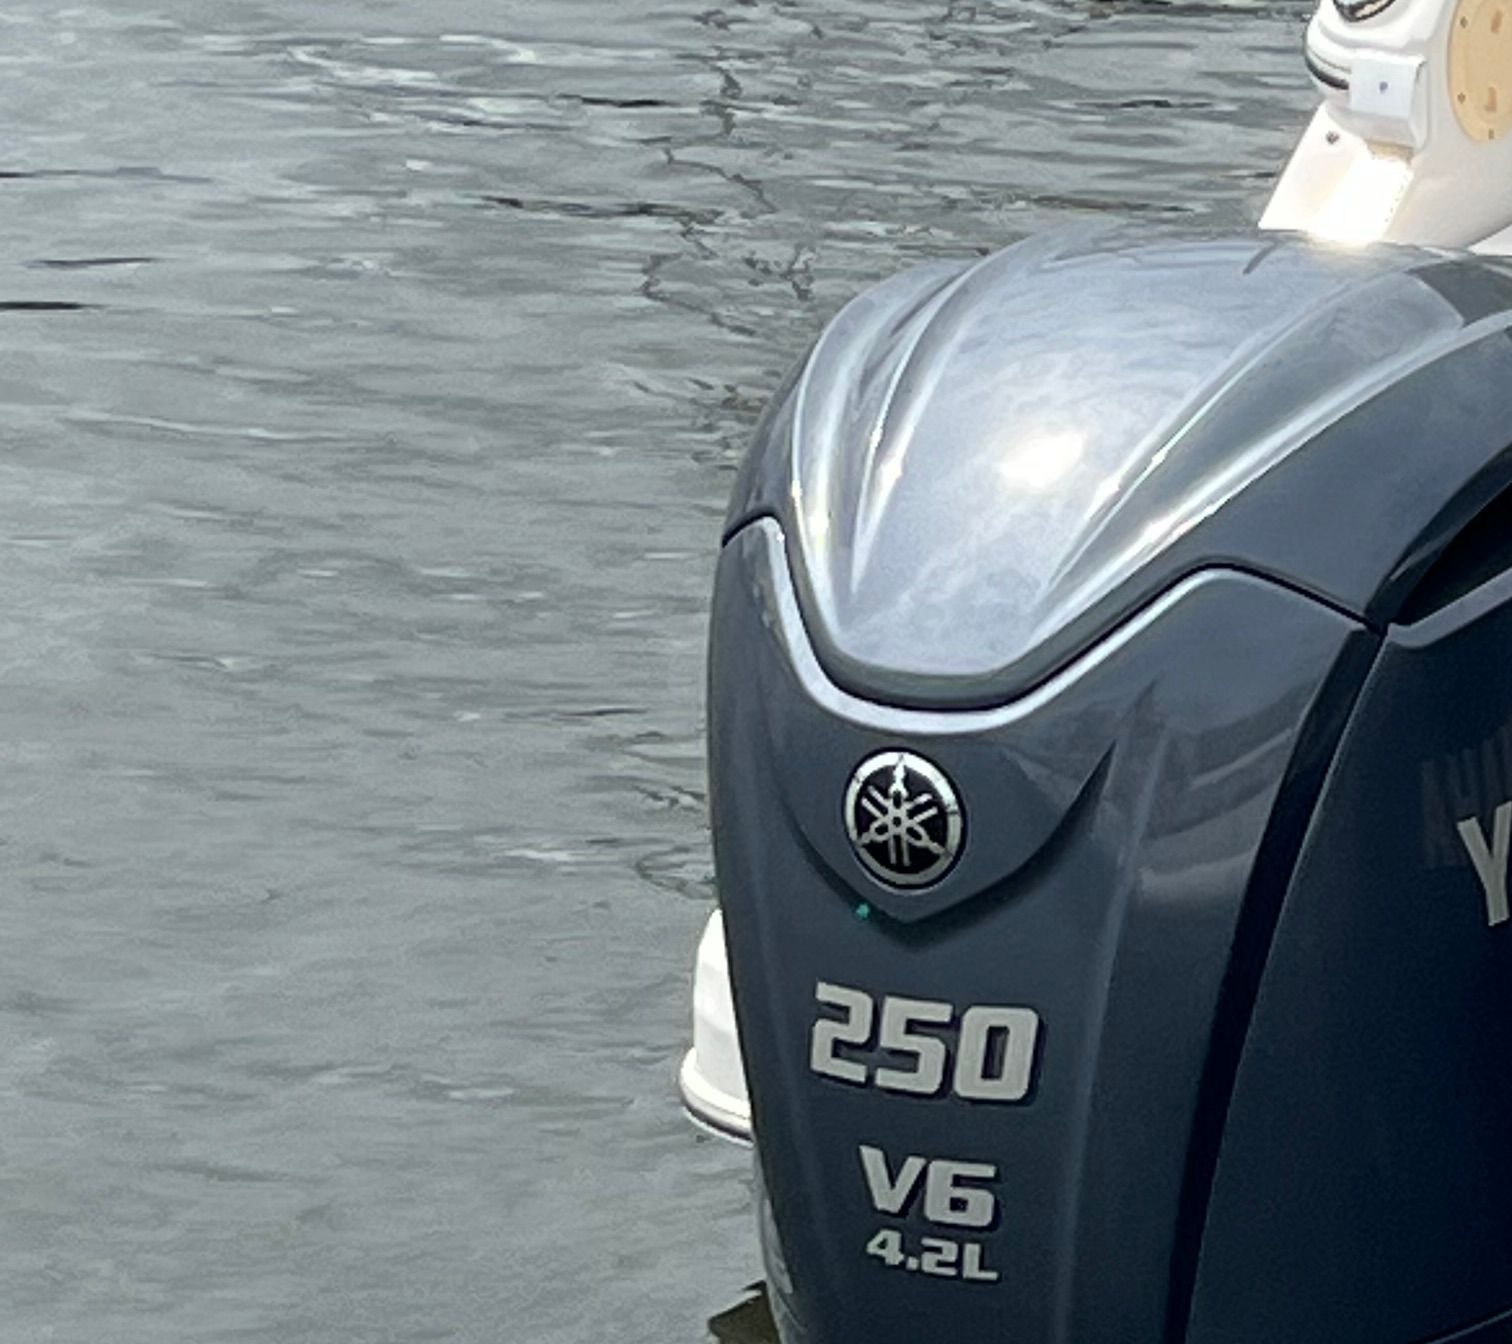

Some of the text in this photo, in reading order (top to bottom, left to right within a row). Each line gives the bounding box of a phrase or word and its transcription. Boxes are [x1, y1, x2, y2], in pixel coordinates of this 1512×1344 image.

[810, 980, 1042, 1103] 250
[858, 1143, 999, 1227] V6
[866, 1227, 999, 1282] 4.2L
